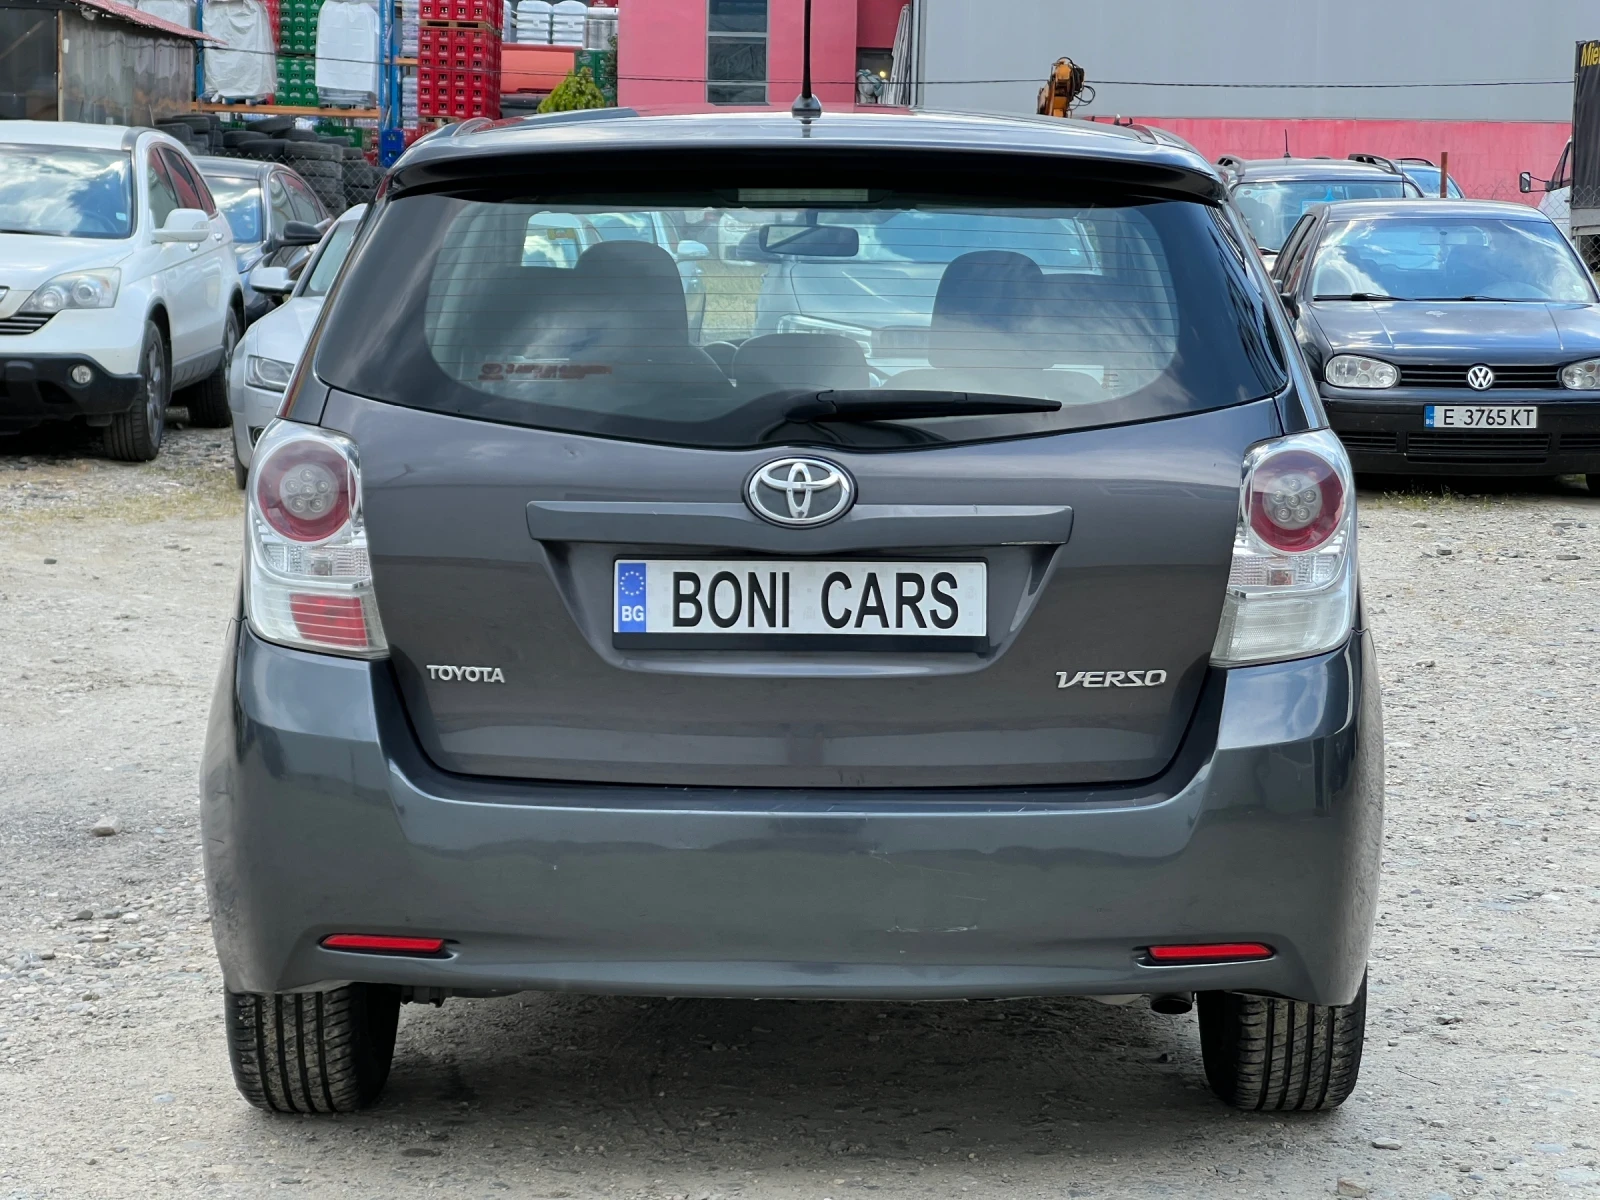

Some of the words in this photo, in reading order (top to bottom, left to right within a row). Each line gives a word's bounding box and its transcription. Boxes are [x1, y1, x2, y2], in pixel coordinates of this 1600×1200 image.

[1443, 409, 1455, 426] E
[672, 571, 790, 628] BONI
[820, 571, 959, 629] CARS
[621, 605, 645, 622] BG
[426, 665, 506, 683] TOYOTA
[1055, 669, 1167, 689] VERSO
